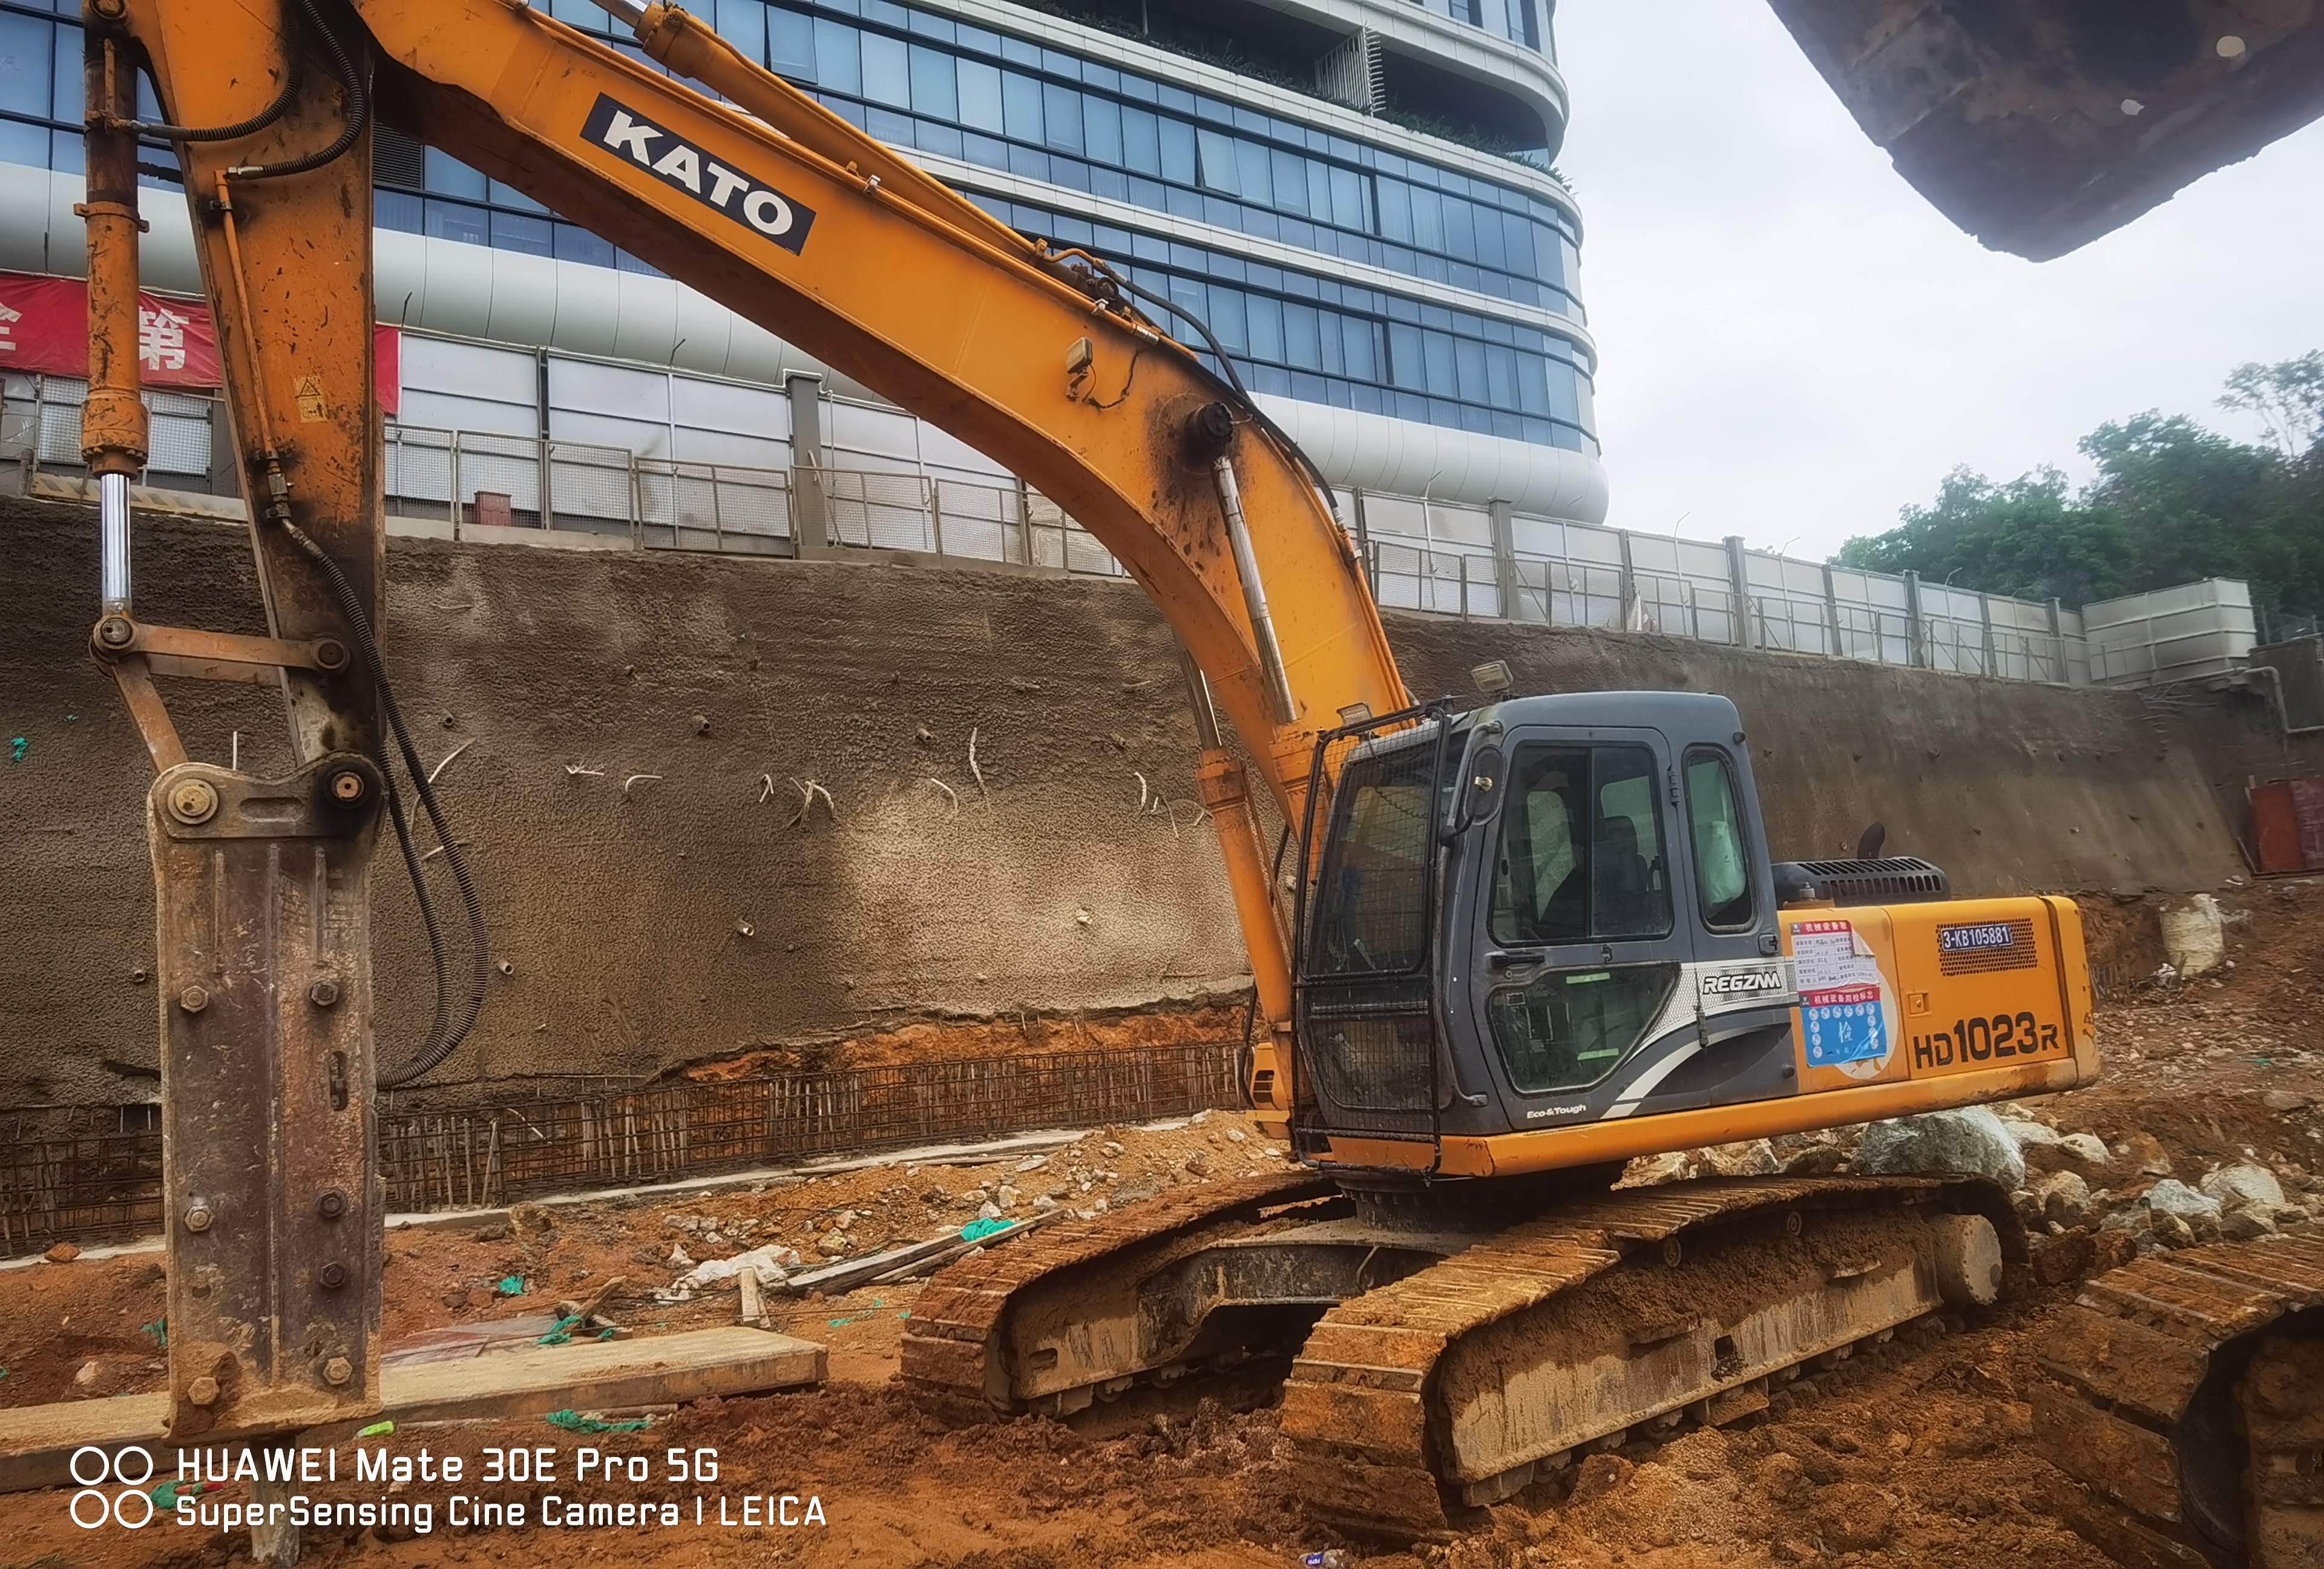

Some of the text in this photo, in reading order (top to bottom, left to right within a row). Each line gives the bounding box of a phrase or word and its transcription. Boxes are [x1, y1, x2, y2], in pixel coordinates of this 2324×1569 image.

[603, 110, 793, 235] KATO
[139, 305, 189, 370] 第
[1943, 926, 2009, 949] 3-KB105881
[1913, 1011, 2060, 1069] HD1023R
[1526, 1104, 1586, 1119] Eco&Tough
